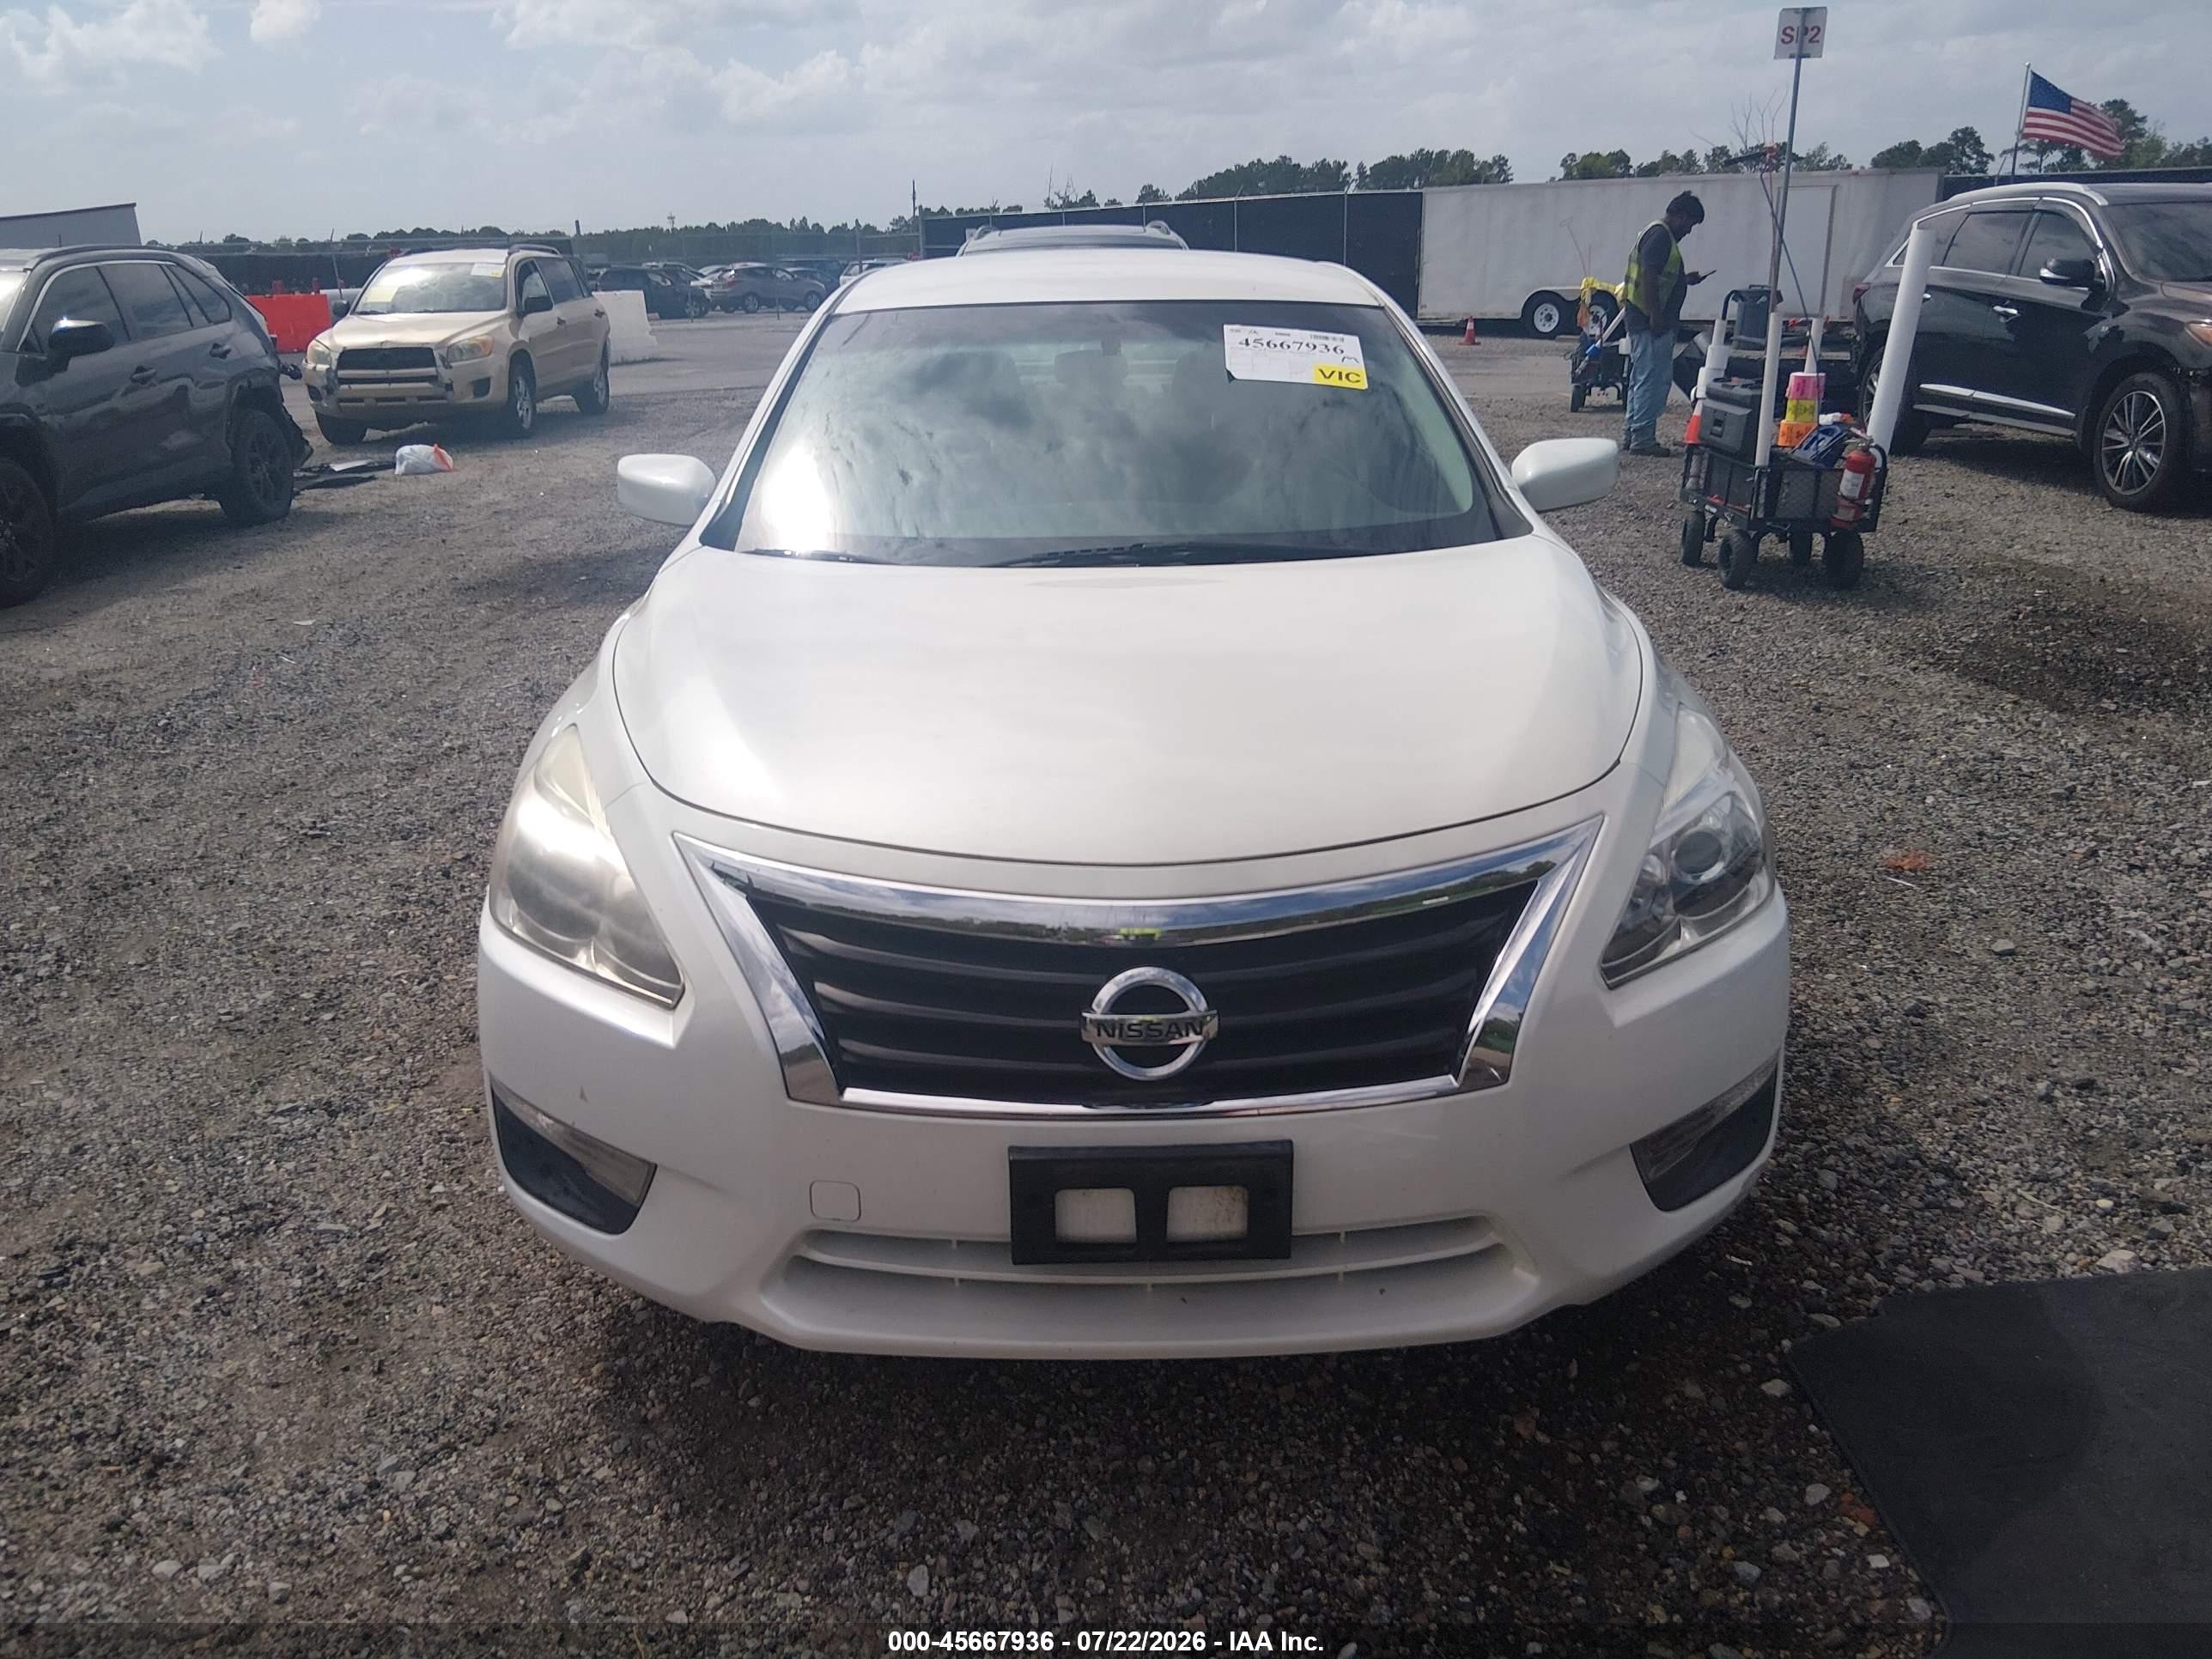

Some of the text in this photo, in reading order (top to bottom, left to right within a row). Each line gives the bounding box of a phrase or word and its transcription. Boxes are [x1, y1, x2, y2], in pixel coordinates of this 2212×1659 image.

[1780, 26, 1821, 45] SP2
[1238, 337, 1345, 356] 45667936
[1318, 368, 1362, 384] VIC
[1097, 1020, 1204, 1038] NISSAN
